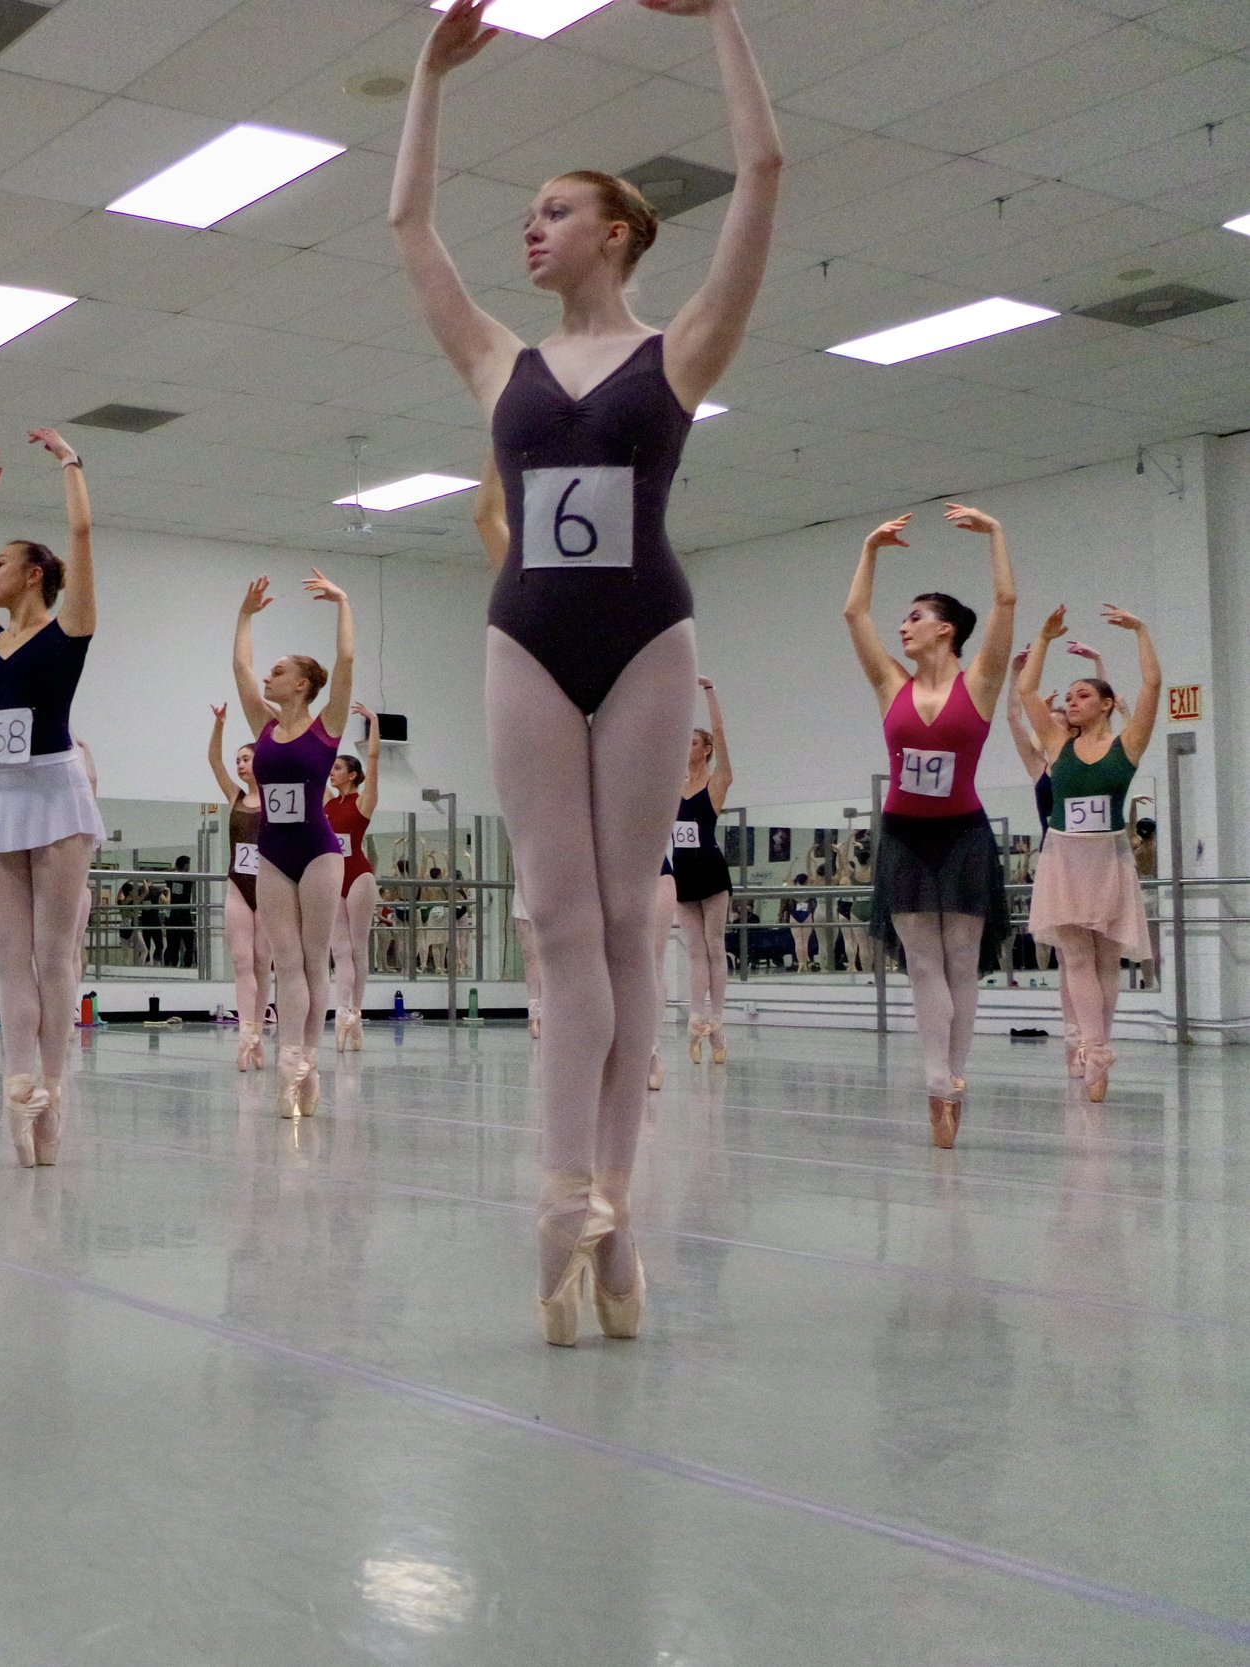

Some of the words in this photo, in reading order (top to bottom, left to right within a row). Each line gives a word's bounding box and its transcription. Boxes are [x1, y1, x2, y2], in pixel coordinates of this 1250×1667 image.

[554, 478, 597, 557] 6
[1170, 687, 1199, 714] EXIT
[906, 754, 942, 789] 49
[268, 789, 298, 814] 61
[1071, 800, 1106, 824] 54
[676, 826, 696, 843] 68
